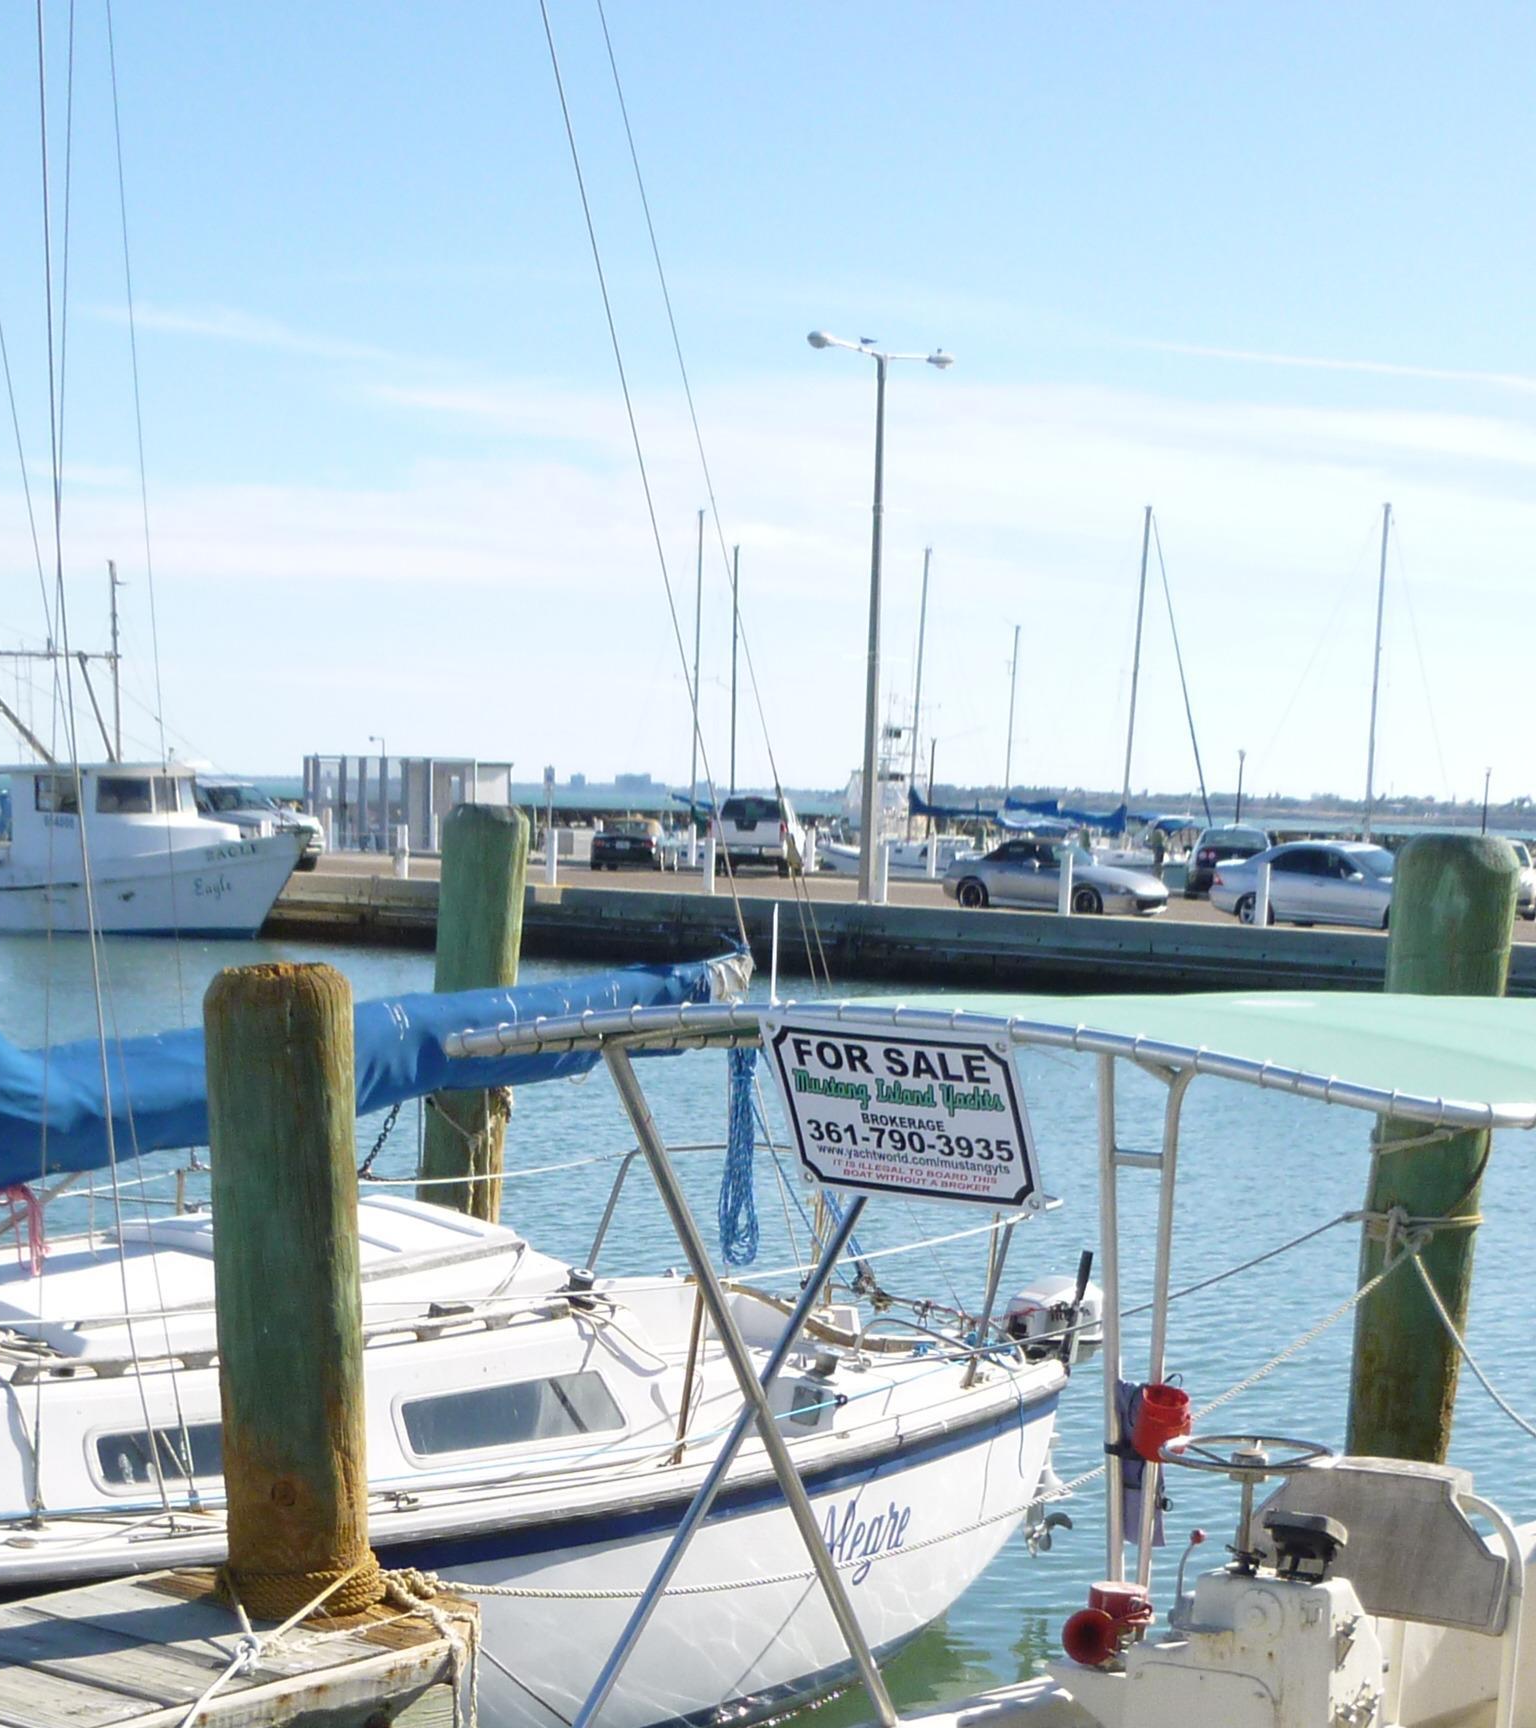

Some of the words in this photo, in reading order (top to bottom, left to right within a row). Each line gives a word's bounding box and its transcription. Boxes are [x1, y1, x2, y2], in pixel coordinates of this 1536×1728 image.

[193, 874, 232, 900] Eagle
[791, 1037, 874, 1075] FOR
[883, 1046, 991, 1085] SALE
[791, 1068, 872, 1110] Mustang
[874, 1077, 936, 1108] Island
[939, 1083, 1006, 1117] Yachts
[860, 1111, 946, 1132] BROKERAGE
[805, 1117, 1014, 1163] 361-790-3935
[833, 1158, 844, 1167] IT
[845, 1160, 856, 1169] IS
[858, 1161, 904, 1175] ILLEGAL
[909, 1167, 924, 1177] TO
[926, 1169, 969, 1182] BOARD
[973, 1174, 998, 1185] THIS
[843, 1168, 873, 1178] BOAT
[875, 1172, 927, 1186] WITHOUT
[929, 1178, 939, 1187] A
[941, 1180, 991, 1192] BROKER
[823, 1500, 912, 1587] Alegre
